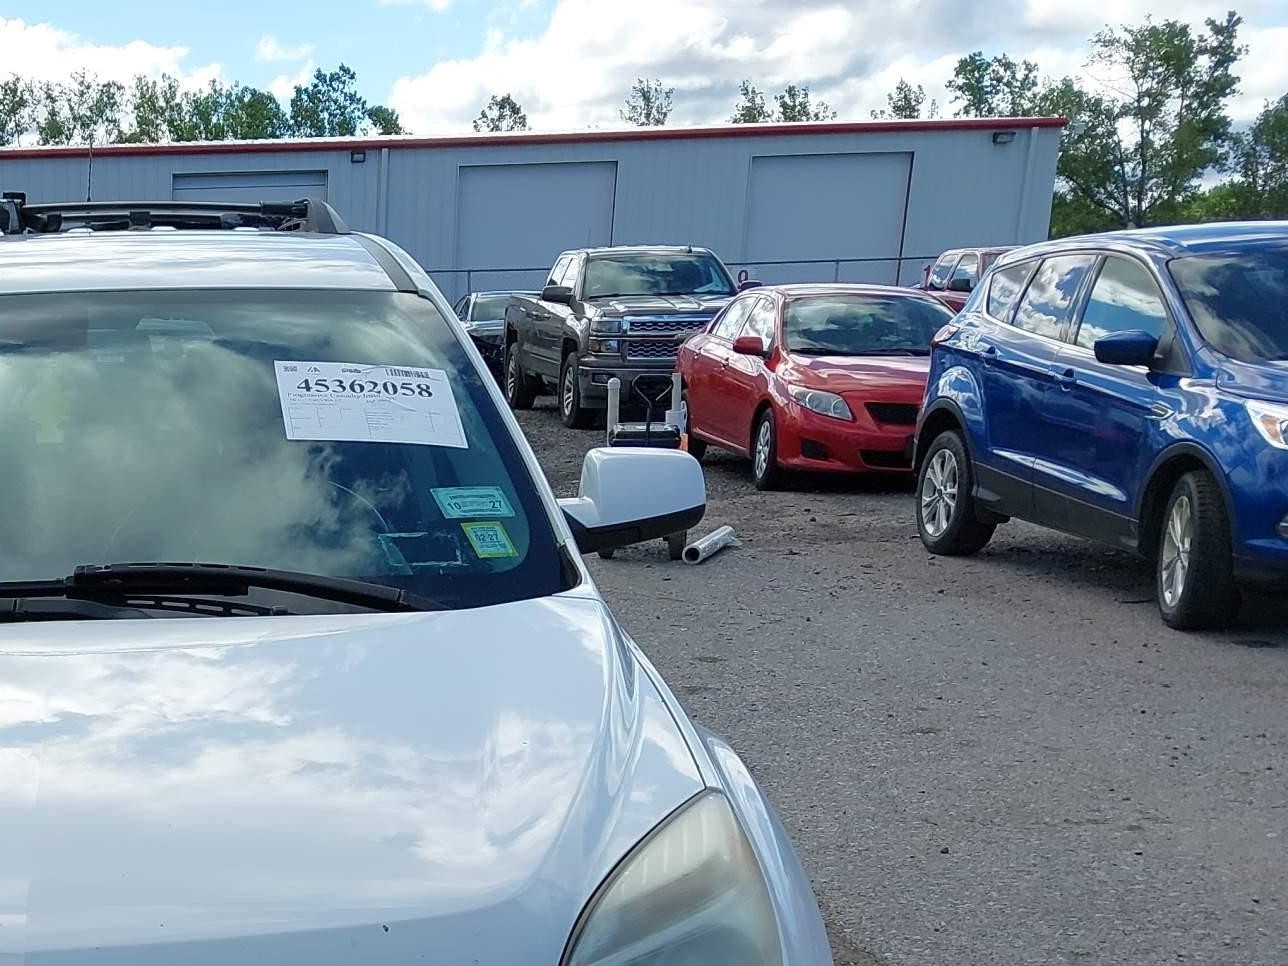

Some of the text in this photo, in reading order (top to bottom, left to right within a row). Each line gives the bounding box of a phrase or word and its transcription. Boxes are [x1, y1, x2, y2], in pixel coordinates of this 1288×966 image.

[297, 378, 433, 398] 45362058
[447, 501, 462, 511] 10
[489, 500, 502, 509] 27
